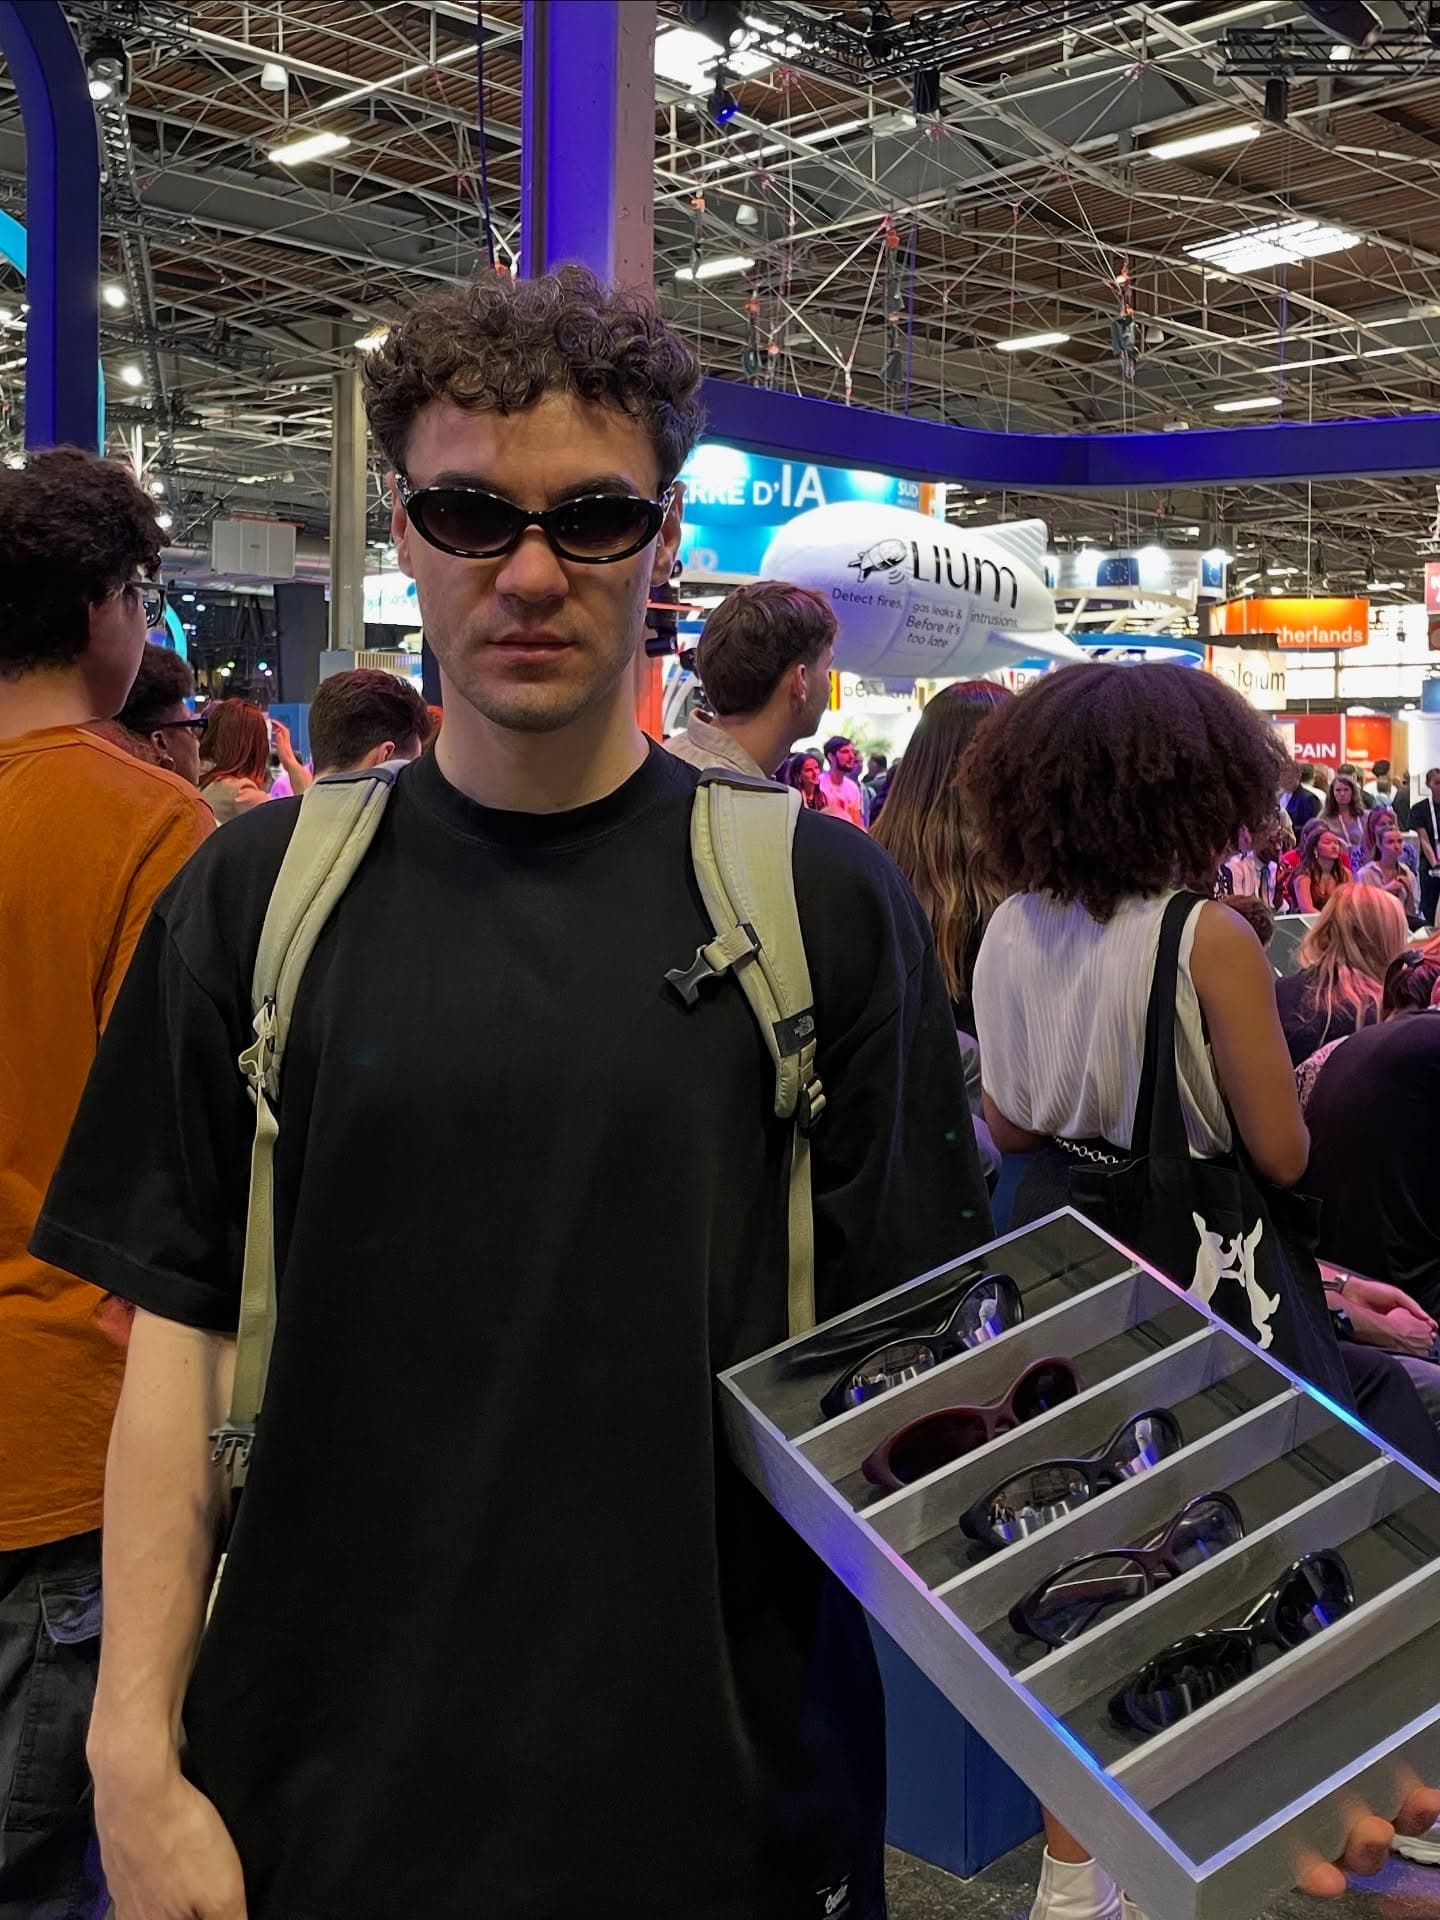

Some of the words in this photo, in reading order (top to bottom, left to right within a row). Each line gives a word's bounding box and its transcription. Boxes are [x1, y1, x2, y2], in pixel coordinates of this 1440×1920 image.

[832, 587, 873, 606] Detect
[912, 603, 929, 614] gas
[931, 604, 954, 618] leaks
[955, 609, 963, 620] &
[906, 615, 945, 633] Before
[946, 621, 961, 635] it's
[907, 633, 926, 645] too
[927, 635, 949, 648] late
[1251, 626, 1363, 644] therlands
[1294, 742, 1337, 759] PAIN
